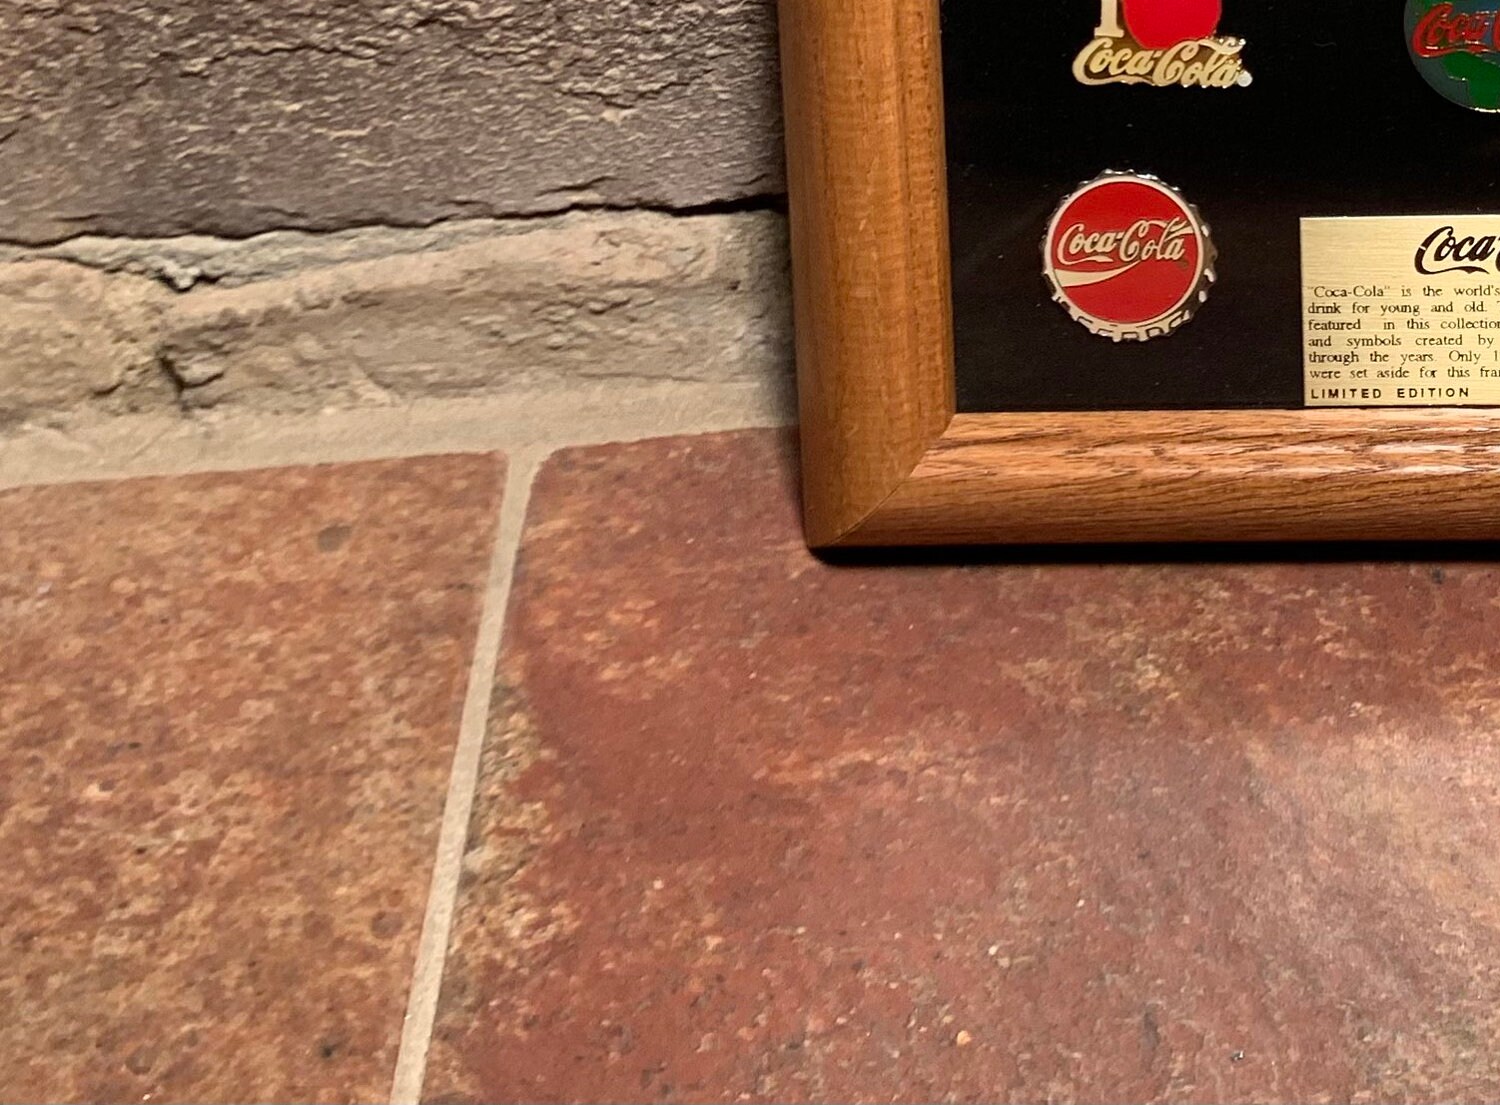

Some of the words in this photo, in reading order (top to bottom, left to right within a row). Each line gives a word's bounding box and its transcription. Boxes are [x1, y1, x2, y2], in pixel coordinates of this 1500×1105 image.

[1072, 38, 1246, 88] Coca-Cola
[1057, 217, 1188, 265] Coca-Cola
[1401, 285, 1411, 296] is
[1423, 285, 1443, 296] the
[1454, 285, 1500, 296] world's
[1308, 303, 1341, 314] drink
[1352, 302, 1370, 313] for
[1381, 304, 1420, 316] young
[1431, 302, 1453, 313] and
[1464, 301, 1487, 312] old.
[1308, 319, 1361, 330] featured
[1383, 319, 1395, 330] in
[1407, 319, 1430, 329] this
[1308, 336, 1331, 347] and
[1347, 335, 1402, 349] symbols
[1415, 334, 1463, 345] created
[1478, 334, 1494, 348] by
[1308, 351, 1359, 366] through
[1370, 351, 1390, 362] the
[1449, 350, 1481, 364] Only
[1310, 370, 1341, 379] were
[1350, 368, 1368, 378] set
[1377, 367, 1410, 378] aside
[1420, 366, 1437, 378] for
[1448, 366, 1470, 378] this
[1311, 388, 1382, 399] LIMITED
[1397, 387, 1469, 398] EDITION
